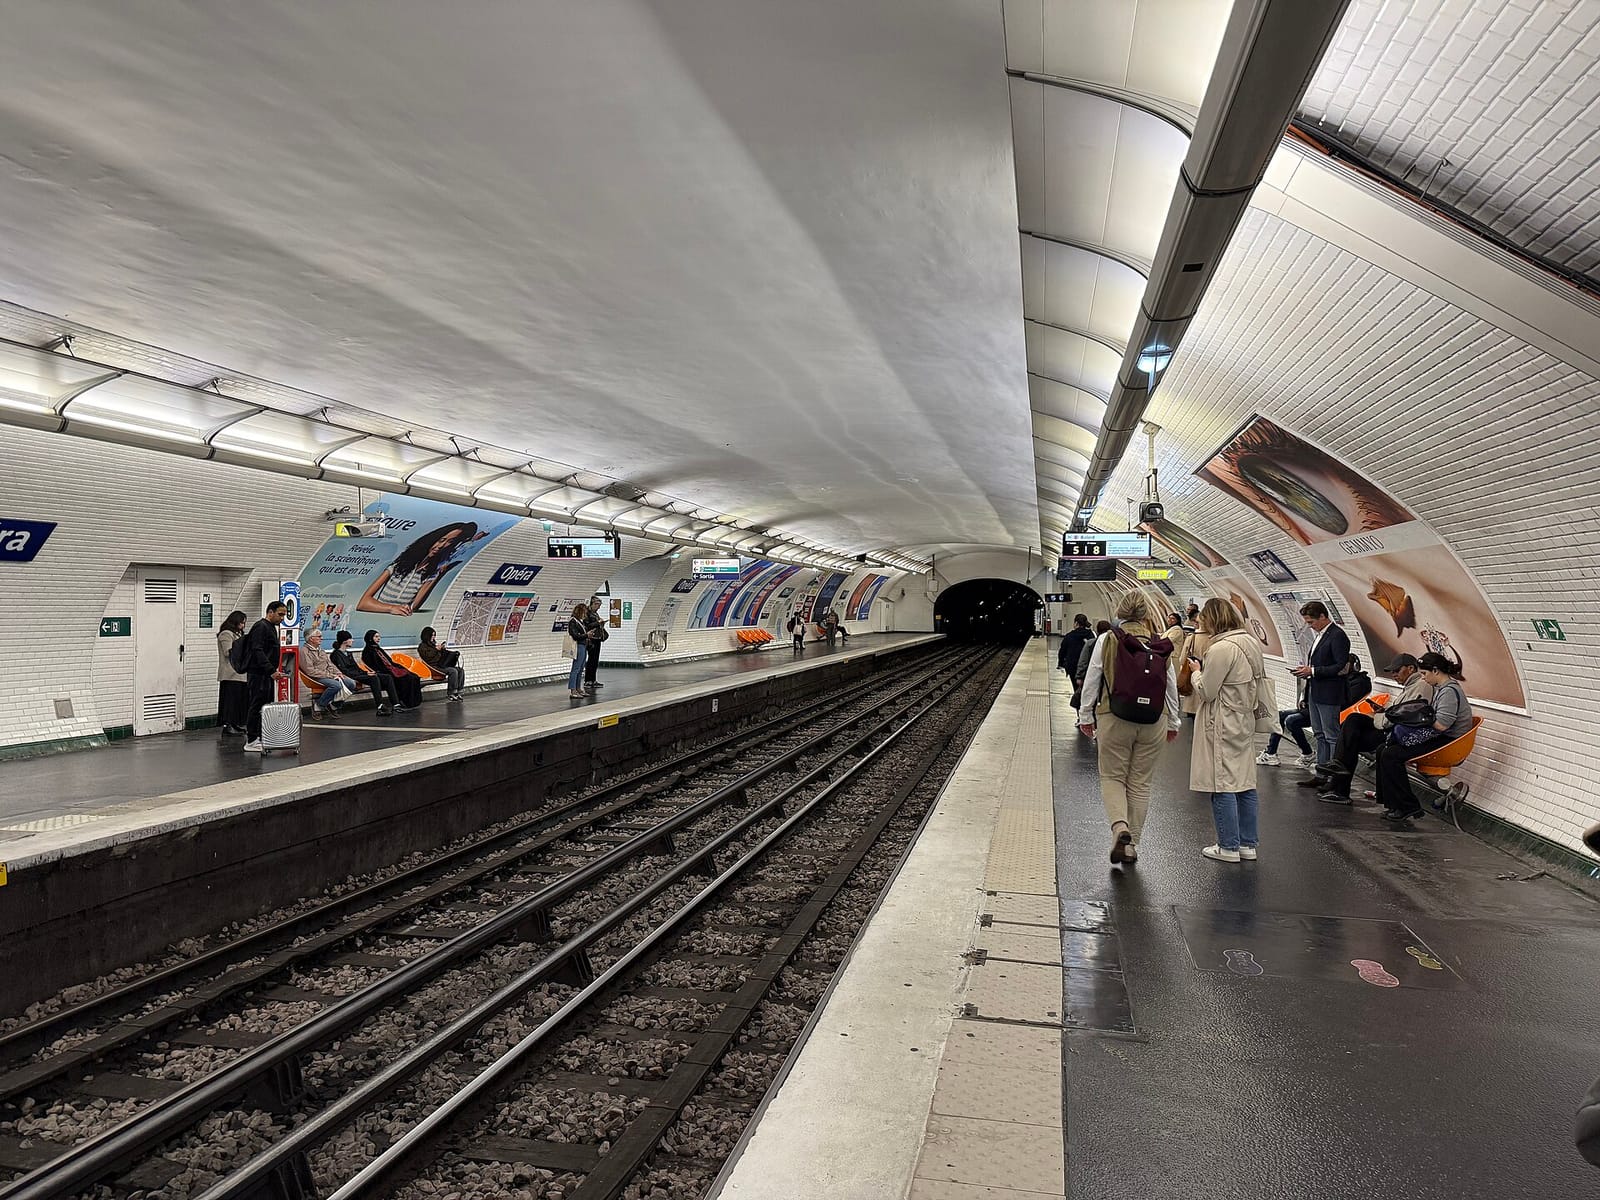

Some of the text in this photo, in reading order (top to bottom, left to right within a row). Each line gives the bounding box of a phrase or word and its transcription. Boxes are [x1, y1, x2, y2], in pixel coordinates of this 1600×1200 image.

[555, 548, 561, 557] 1
[571, 548, 578, 557] 8
[1072, 545, 1080, 555] 5
[1092, 545, 1101, 555] 8
[325, 552, 380, 567] la scientifique
[333, 566, 349, 574] est
[346, 567, 359, 575] en
[358, 566, 374, 576] toi
[500, 565, 535, 583] Opéra
